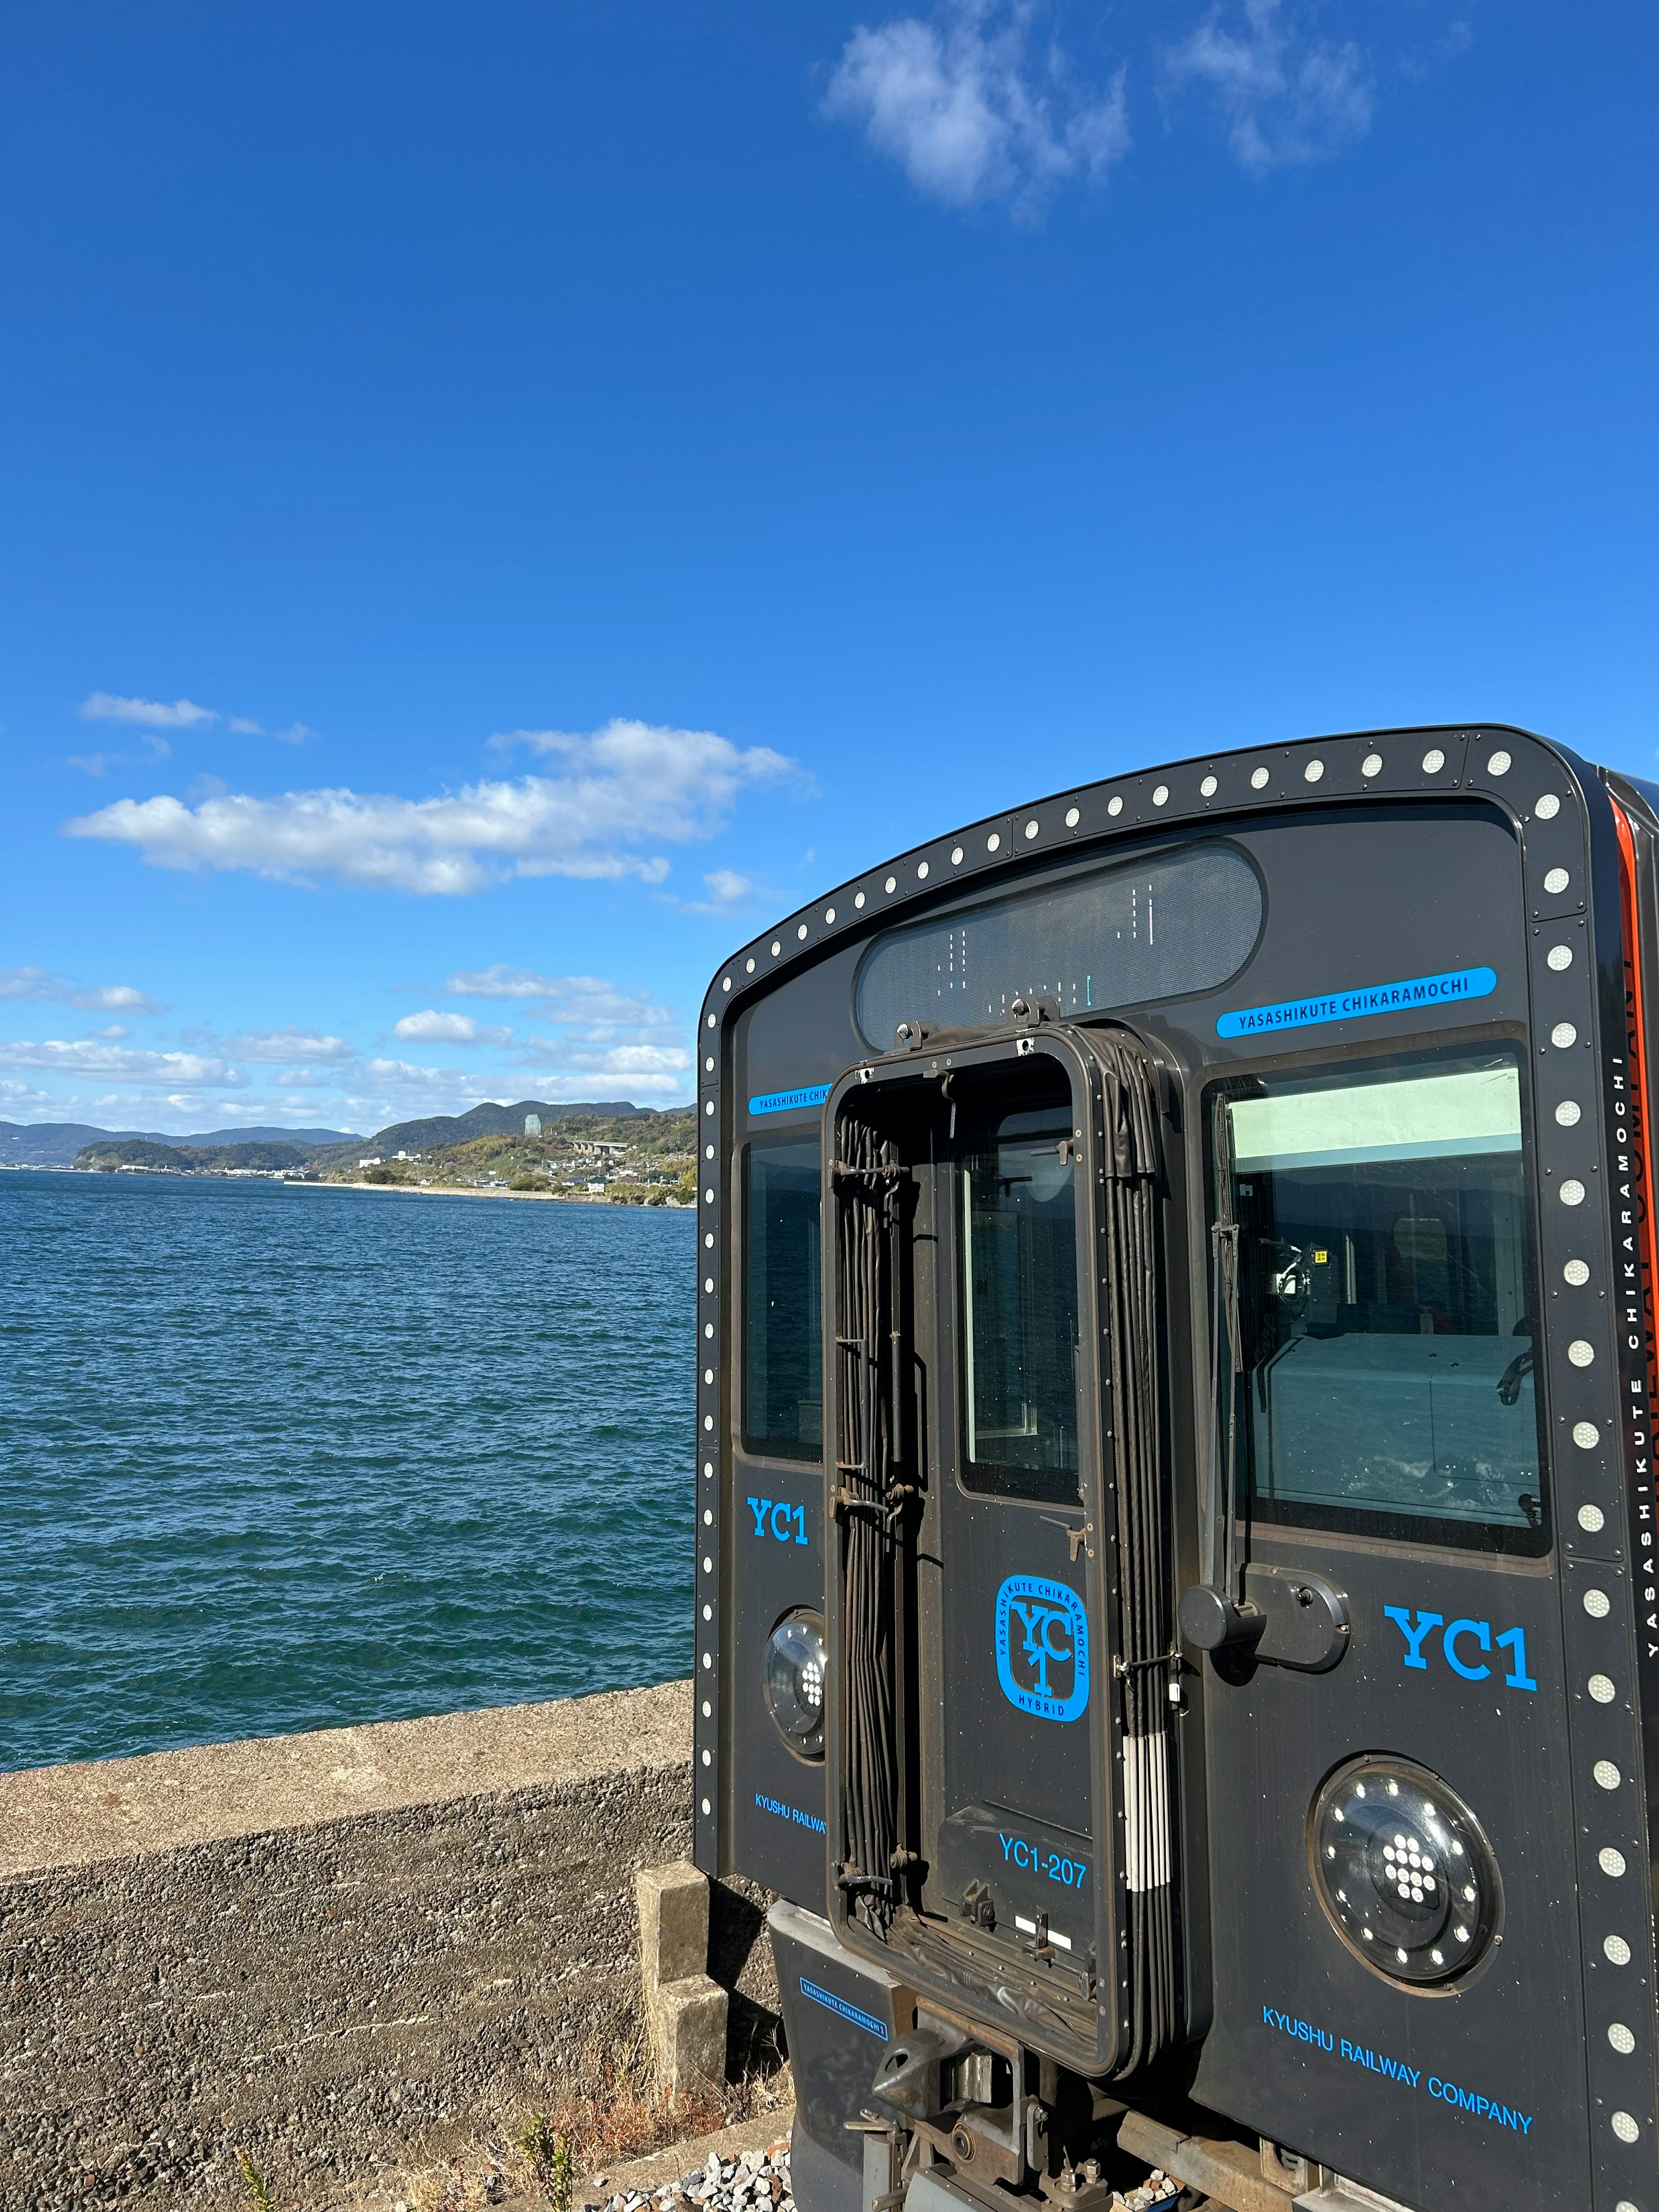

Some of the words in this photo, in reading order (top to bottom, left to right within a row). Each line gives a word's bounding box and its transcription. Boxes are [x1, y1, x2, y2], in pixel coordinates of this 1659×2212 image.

[1239, 1000, 1337, 1030] YASASHIKUTE
[1342, 977, 1468, 1012] CHIKARAMOCHI
[760, 1093, 807, 1109] YASASHIKUTE
[810, 1089, 830, 1101] CHIK
[1612, 1058, 1639, 1349] CHIKARAMOCHI
[747, 1497, 808, 1545] YC1
[1631, 1379, 1659, 1658] YASASHIKUTE
[1000, 1583, 1033, 1656] YASASHIKUTE
[1038, 1585, 1085, 1676] CHIKARAMOCHI
[1011, 1601, 1073, 1698] YC1
[1384, 1605, 1537, 1692] YC1
[1019, 1694, 1064, 1716] HYBRID
[756, 1793, 790, 1819] KYUSHU
[792, 1808, 826, 1834] RAILWA
[999, 1834, 1087, 1888] YC1-207
[803, 1983, 838, 2009] YASASHIKUTE
[839, 2004, 880, 2031] CHIKARAMOCHI
[1263, 2006, 1333, 2052] KYUSHU
[1341, 2039, 1421, 2088] RAILWAY
[1428, 2077, 1533, 2135] COMPANY
